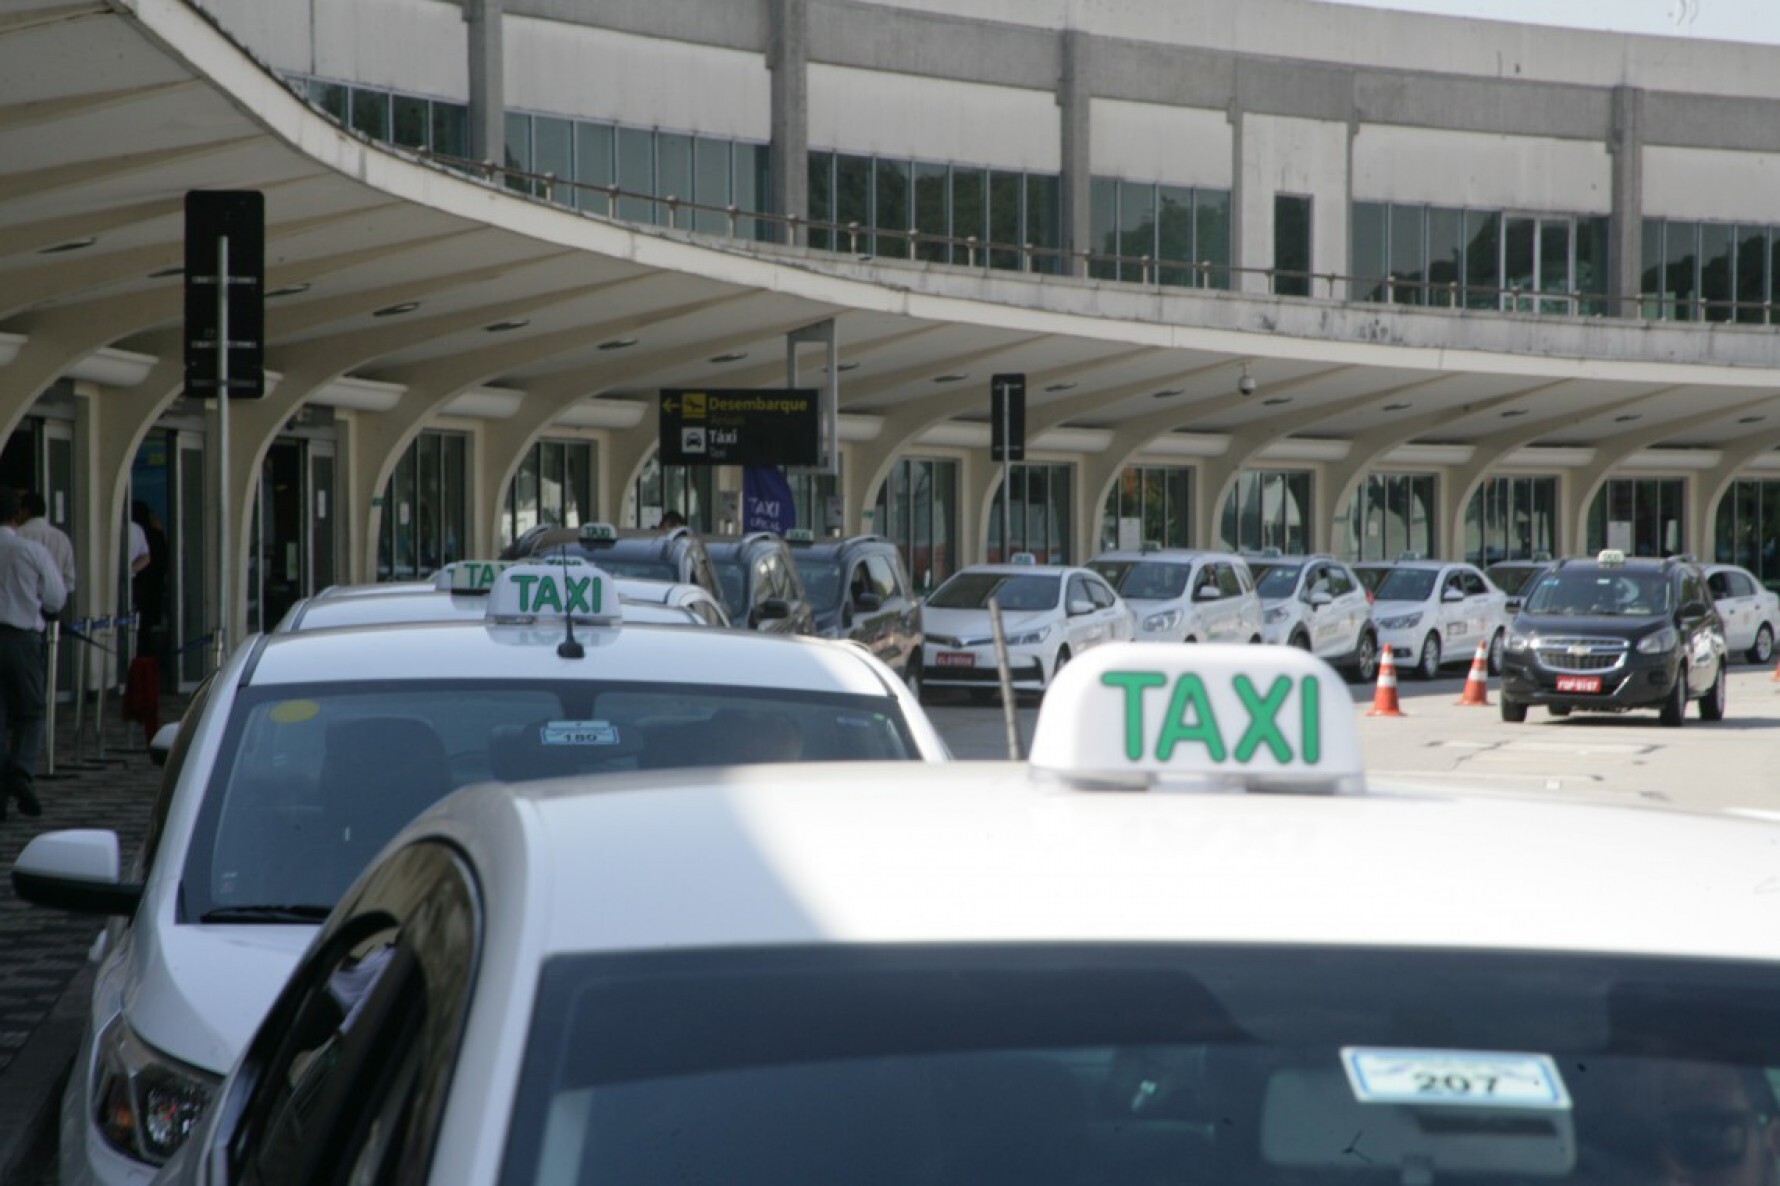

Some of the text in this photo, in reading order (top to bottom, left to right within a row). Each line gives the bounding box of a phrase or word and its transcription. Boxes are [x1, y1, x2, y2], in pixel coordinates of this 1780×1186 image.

[709, 396, 807, 414] Desembarque
[709, 428, 738, 444] Táxi
[510, 575, 604, 613] TAXI
[1100, 671, 1321, 765] TAXI
[1413, 1072, 1498, 1094] 207
